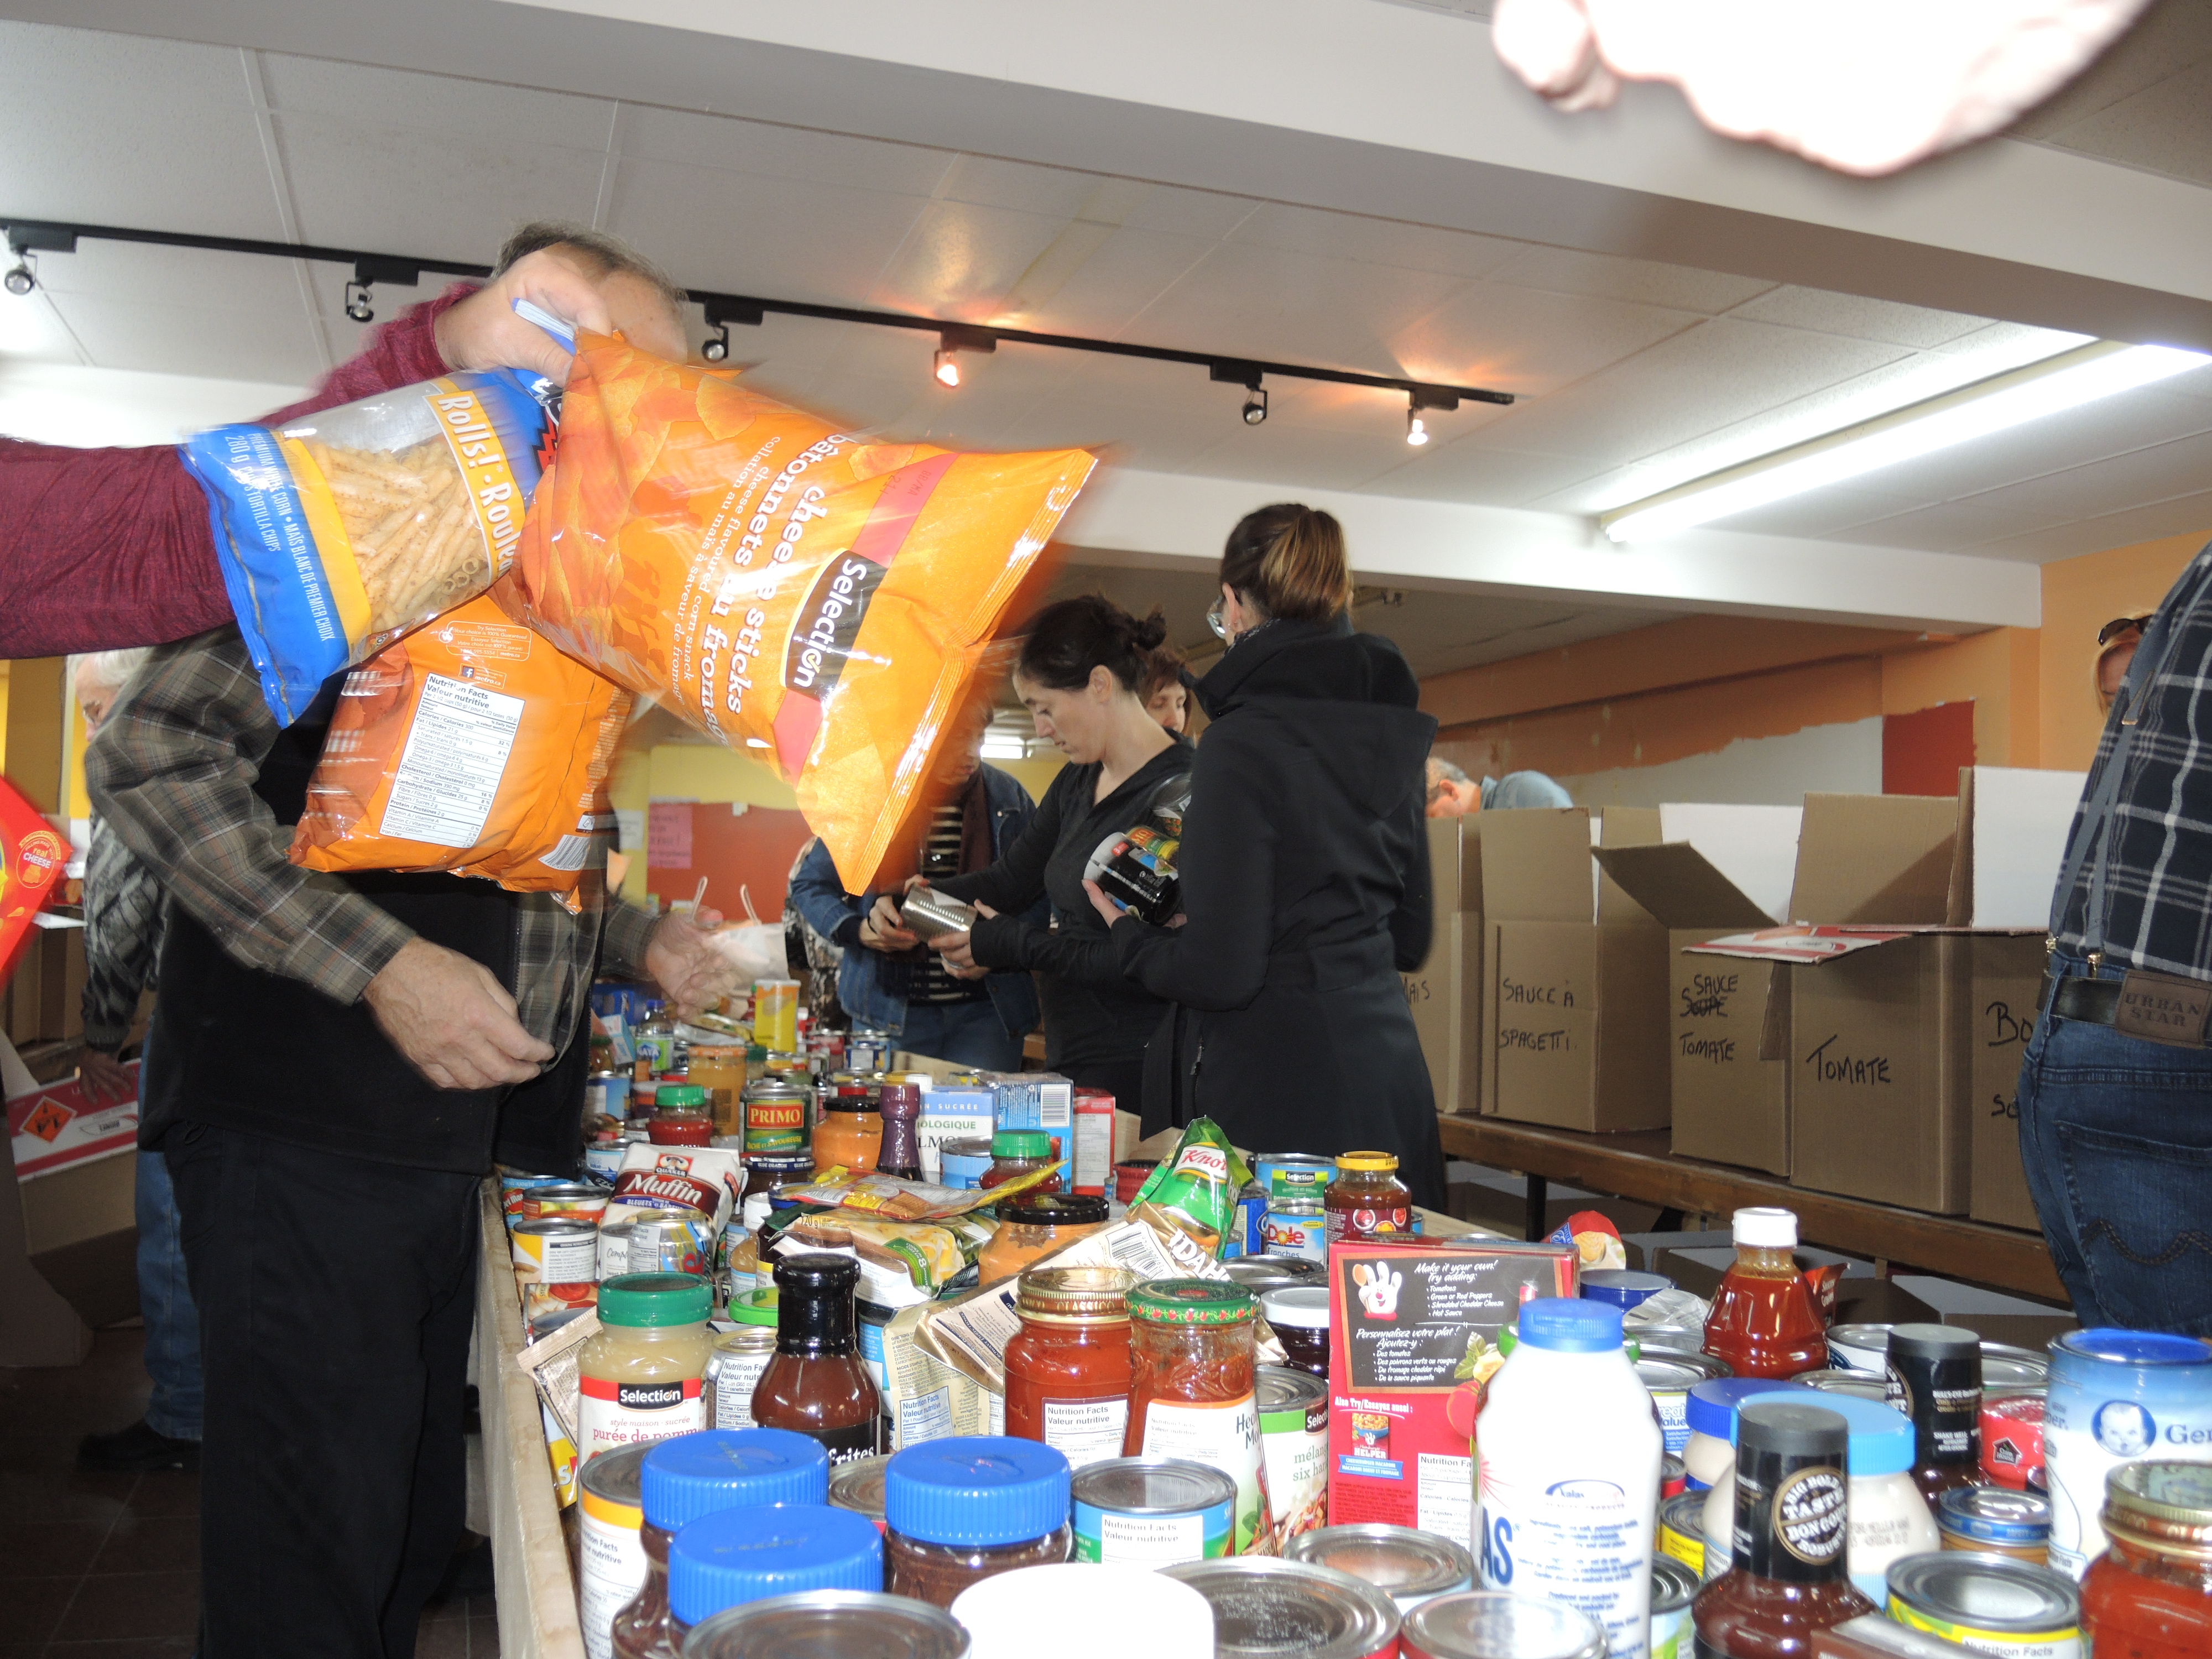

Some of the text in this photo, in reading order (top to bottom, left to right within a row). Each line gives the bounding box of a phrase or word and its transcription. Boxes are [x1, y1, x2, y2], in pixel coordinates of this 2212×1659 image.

[733, 436, 781, 492] collation
[225, 435, 281, 552] 280 TORTILLA CHIPS
[734, 434, 847, 567] bâtonnets
[721, 492, 735, 510] au
[248, 433, 335, 641] PREMIUM WHITE CORN MAÏS BLANC DE PREMIER CHOIX
[702, 511, 725, 550] maïs
[695, 552, 705, 564] à
[684, 466, 769, 682] cheese flavoured corn snack
[677, 565, 698, 620] saveur
[711, 572, 739, 618] au
[727, 485, 828, 715] cheee sticks
[793, 557, 868, 688] Selection
[674, 623, 685, 643] de
[474, 675, 502, 686] metro.ca
[429, 676, 488, 700] Nutrition Facts
[427, 684, 489, 708] Valeur nutritive
[418, 710, 463, 728] Calories Calories
[401, 764, 431, 777] Cholesterol
[397, 778, 432, 792] Carbohydrate
[390, 799, 410, 808] Protein
[388, 807, 406, 816] Vitamin
[33, 848, 48, 858] real
[23, 852, 51, 869] CHEESE
[1503, 978, 1556, 1005] SAUCE
[1693, 974, 1739, 995] SAUCE
[2125, 992, 2201, 1015] URBAN
[2130, 1007, 2187, 1027] STAR
[1679, 1031, 1735, 1063] TOMATE
[1806, 1034, 1891, 1084] TOMATE
[938, 1102, 979, 1111] SUCRÉE
[750, 1108, 801, 1123] PRIMO
[768, 1136, 802, 1147] SAVOUREUSE
[656, 1167, 686, 1176] QUAKER
[1286, 1173, 1314, 1181] Selection
[623, 1173, 702, 1205] Muffin
[1268, 1224, 1305, 1245] Dole
[1267, 1248, 1300, 1258] Tranches
[918, 1258, 927, 1267] 8
[1415, 1260, 1499, 1274] Make it your own!
[1428, 1272, 1442, 1284] Try
[1057, 1300, 1115, 1312] CLASSICO
[1356, 1328, 1410, 1339] Personnalisez
[1434, 1326, 1453, 1339] plat
[1376, 1338, 1417, 1350] Ajoutez-y
[724, 1362, 752, 1371] Nutrition
[1437, 1358, 1457, 1366] rouges
[721, 1371, 742, 1380] Valeur
[620, 1389, 681, 1402] Selection
[903, 1394, 939, 1410] Nutrition Facts
[1334, 1396, 1349, 1407] Also
[903, 1402, 941, 1418] Valeur nutritive
[1048, 1406, 1108, 1415] Nutrition Facts
[610, 1418, 627, 1427] style
[665, 1416, 690, 1426] sucrée
[1048, 1415, 1109, 1425] Valeur nutritive
[593, 1428, 648, 1443] purée de
[828, 1446, 874, 1467] frites
[1354, 1447, 1386, 1459] HELPER
[1997, 1452, 2014, 1462] HOUSE
[1999, 1447, 2013, 1456] CLUB
[1421, 1456, 1458, 1467] Nutrition
[1293, 1468, 1310, 1481] six
[1783, 1481, 1808, 1505] BIG
[1806, 1474, 1840, 1489] BOLD
[1782, 1486, 1845, 1520] TASTE
[1104, 1519, 1146, 1531] Nutrition
[1785, 1520, 1820, 1542] BON
[1104, 1531, 1133, 1541] Valeur
[599, 1538, 618, 1553] Facts
[592, 1547, 622, 1565] nutritive
[2023, 1647, 2053, 1656] Facts
